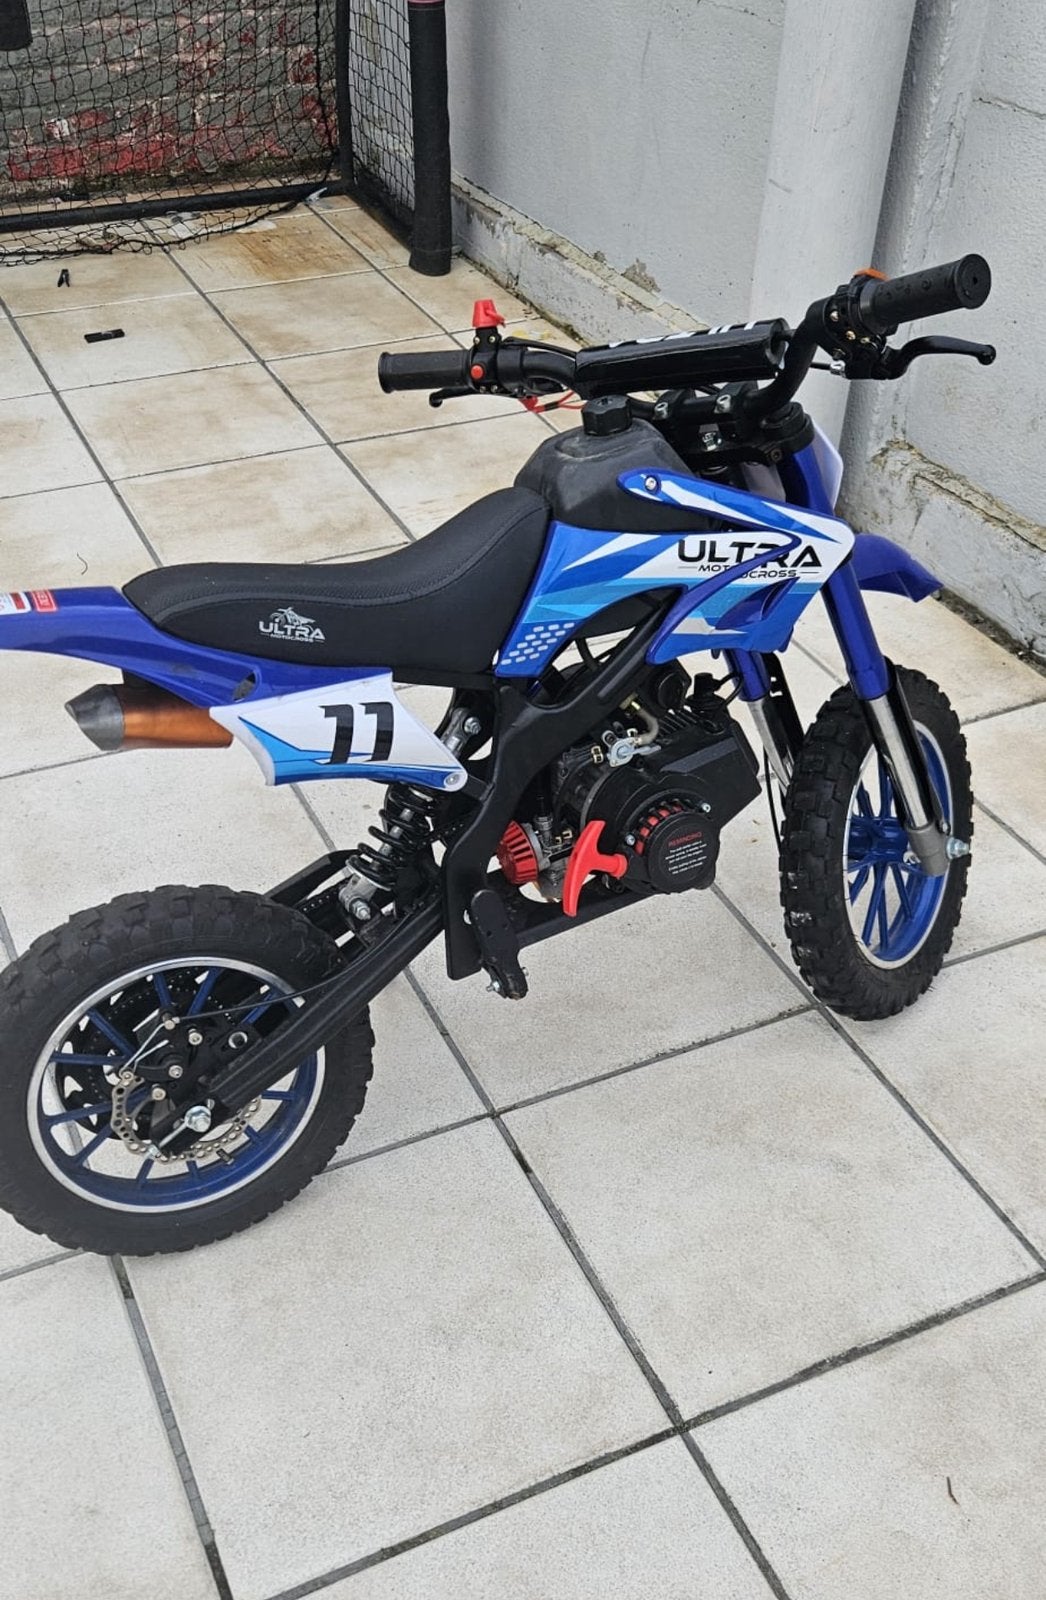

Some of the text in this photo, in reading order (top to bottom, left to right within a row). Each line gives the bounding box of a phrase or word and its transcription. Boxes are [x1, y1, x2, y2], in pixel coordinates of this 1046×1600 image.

[678, 539, 822, 568] ULTRA
[259, 620, 325, 640] ULTRA
[270, 633, 313, 643] MOTOCROSS
[318, 701, 394, 765] 11
